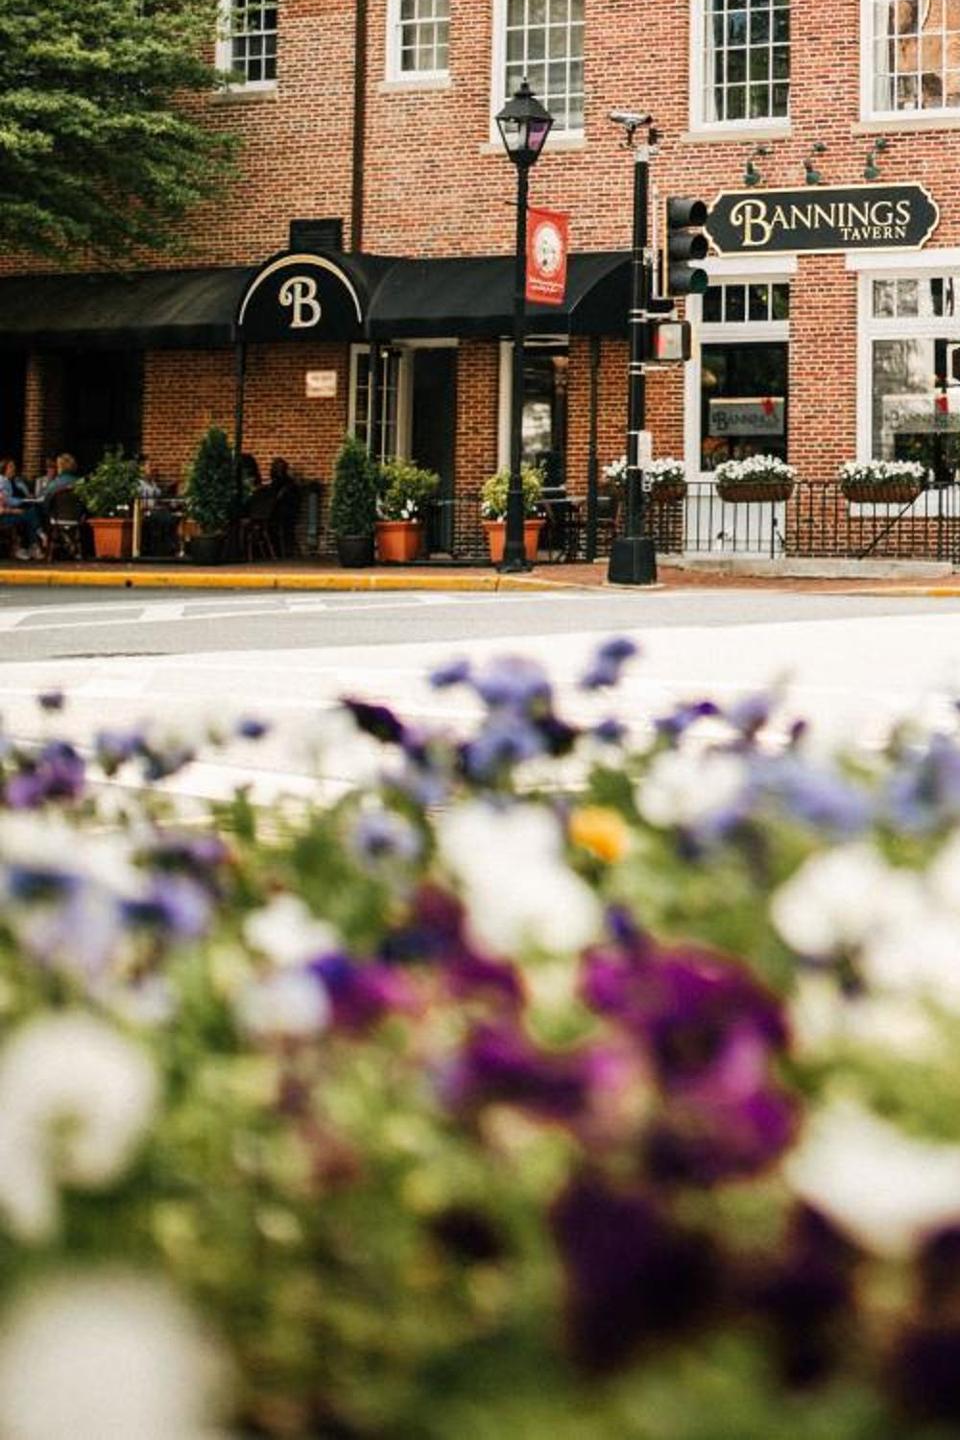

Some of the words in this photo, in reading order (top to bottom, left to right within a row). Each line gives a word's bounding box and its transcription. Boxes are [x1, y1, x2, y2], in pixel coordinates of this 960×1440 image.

[730, 198, 911, 247] BANNINGS
[841, 224, 907, 241] TAVERN
[278, 275, 322, 329] B
